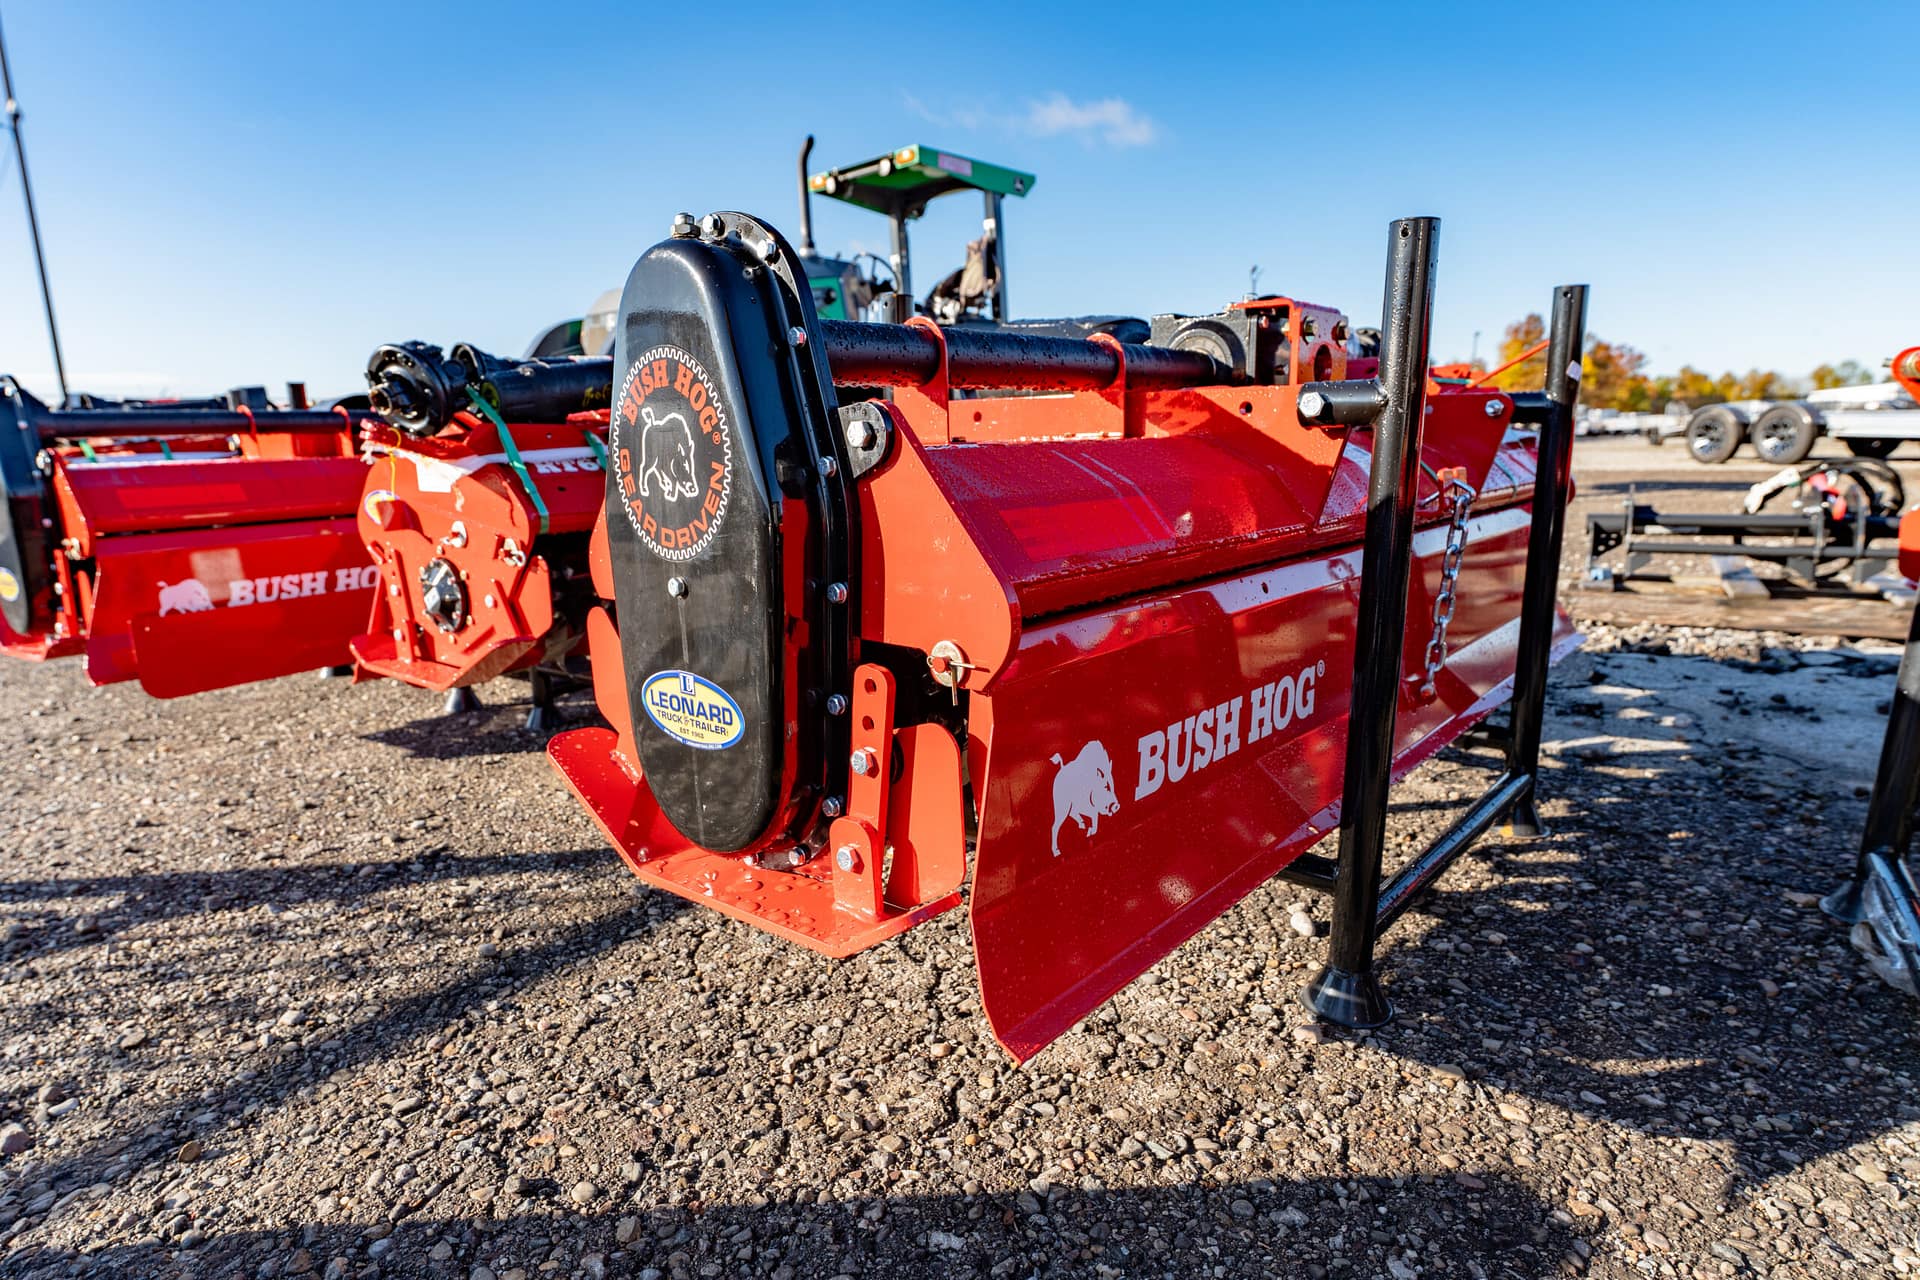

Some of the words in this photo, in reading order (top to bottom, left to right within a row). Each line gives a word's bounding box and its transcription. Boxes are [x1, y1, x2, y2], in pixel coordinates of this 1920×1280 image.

[622, 359, 669, 426] BUSH
[620, 448, 657, 539] GEAR
[660, 461, 724, 548] DRIVEN
[227, 571, 329, 608] BUSH
[334, 565, 380, 593] HO
[650, 688, 733, 726] LEONARD
[656, 709, 682, 725] TRUCK
[690, 718, 726, 736] TRAILER
[1134, 695, 1243, 802] BUSH
